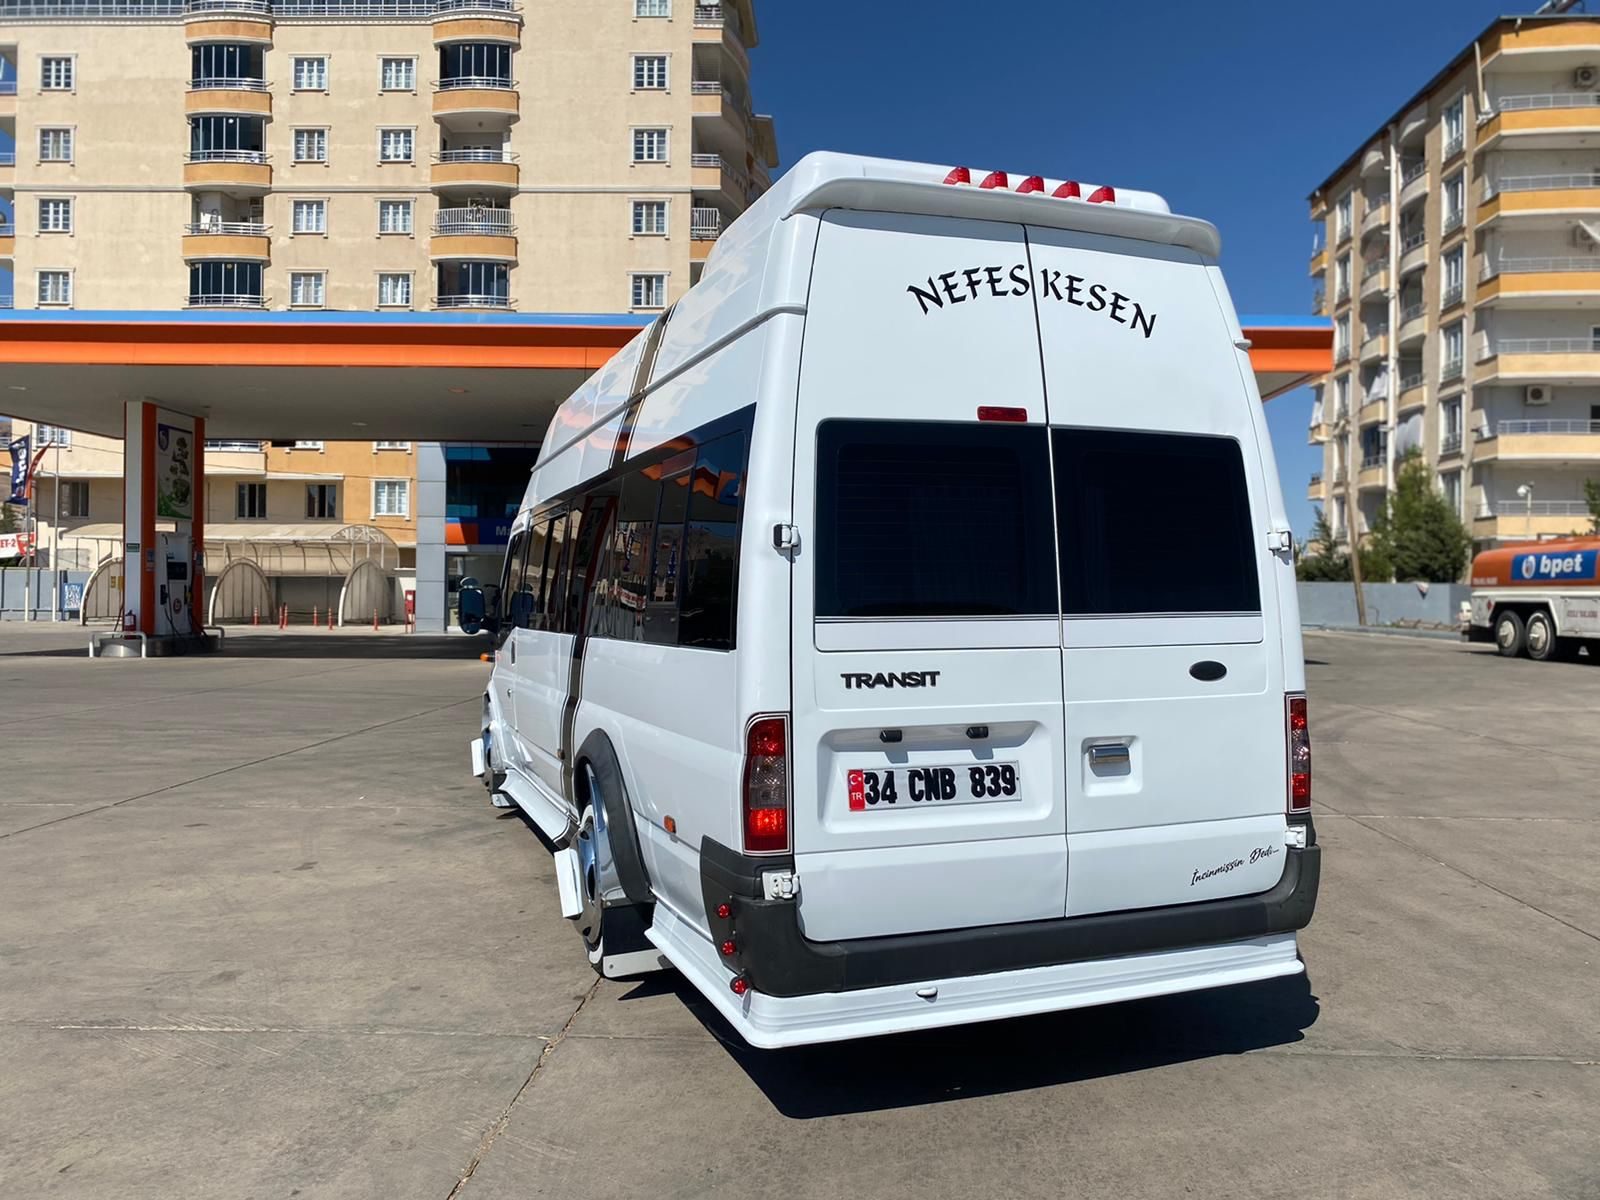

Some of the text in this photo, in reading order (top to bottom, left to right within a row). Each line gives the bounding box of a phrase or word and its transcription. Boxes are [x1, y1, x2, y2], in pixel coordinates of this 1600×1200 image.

[907, 264, 1156, 339] NEFES KESEN
[0, 539, 16, 548] ET-2
[1540, 553, 1583, 578] bpet
[840, 671, 940, 689] TRANSIT
[864, 764, 1016, 805] 34 CNB 839
[851, 792, 862, 800] TR
